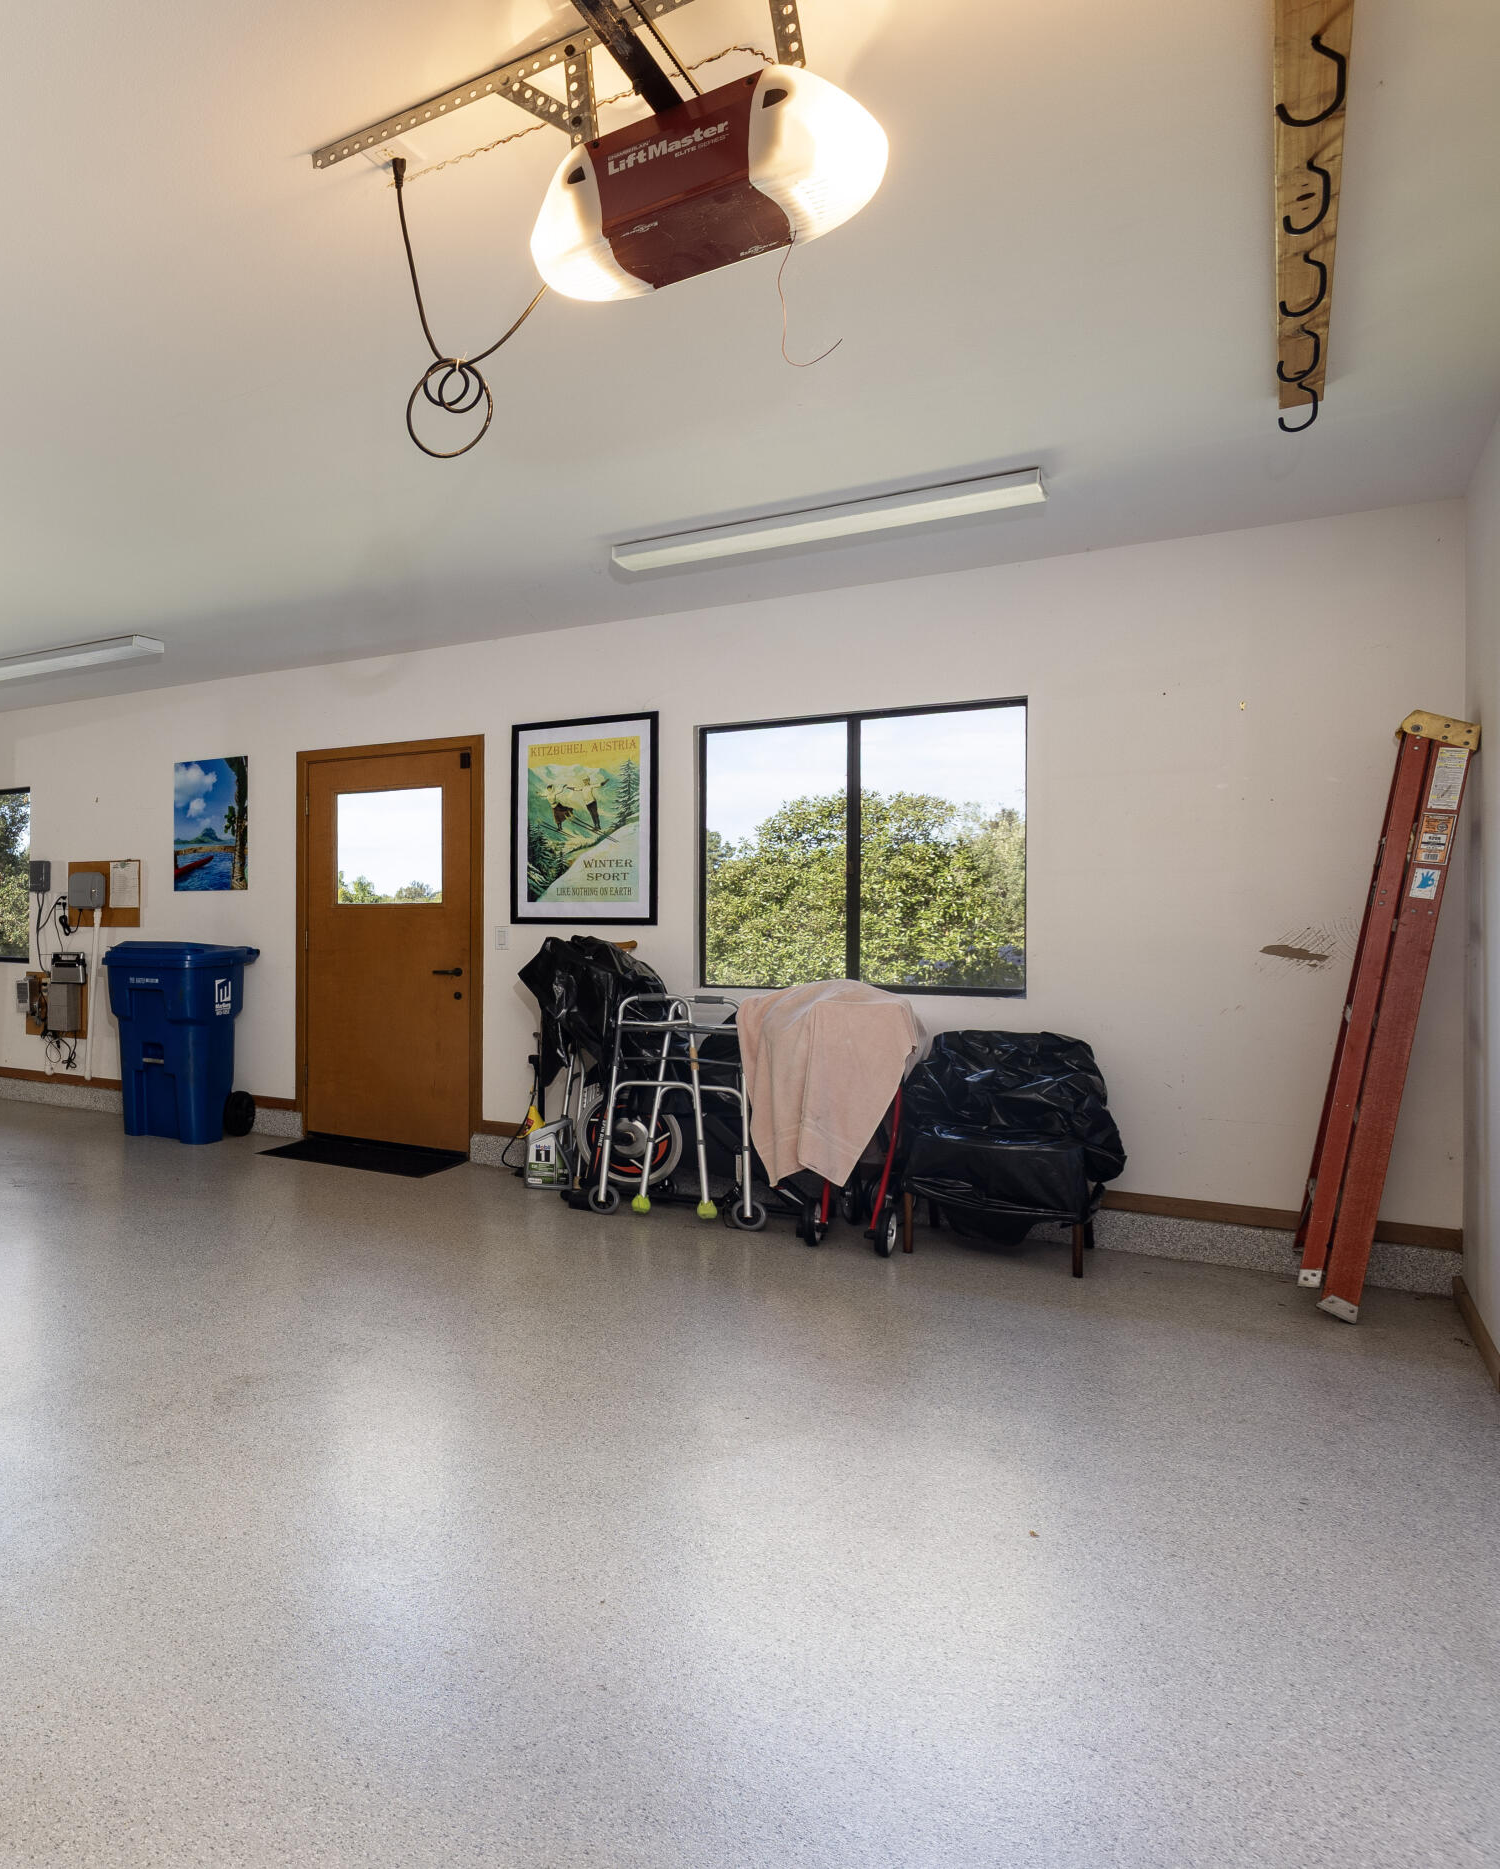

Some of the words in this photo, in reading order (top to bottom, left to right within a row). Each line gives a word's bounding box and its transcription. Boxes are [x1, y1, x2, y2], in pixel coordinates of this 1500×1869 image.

[608, 120, 729, 176] LiftMaster
[591, 739, 637, 752] AUSTRIA
[583, 858, 633, 868] WINTER
[586, 872, 629, 881] SPORT
[556, 887, 571, 896] LIKE
[572, 887, 598, 896] NOTHING
[600, 887, 609, 896] ON
[610, 886, 632, 896] EARTH
